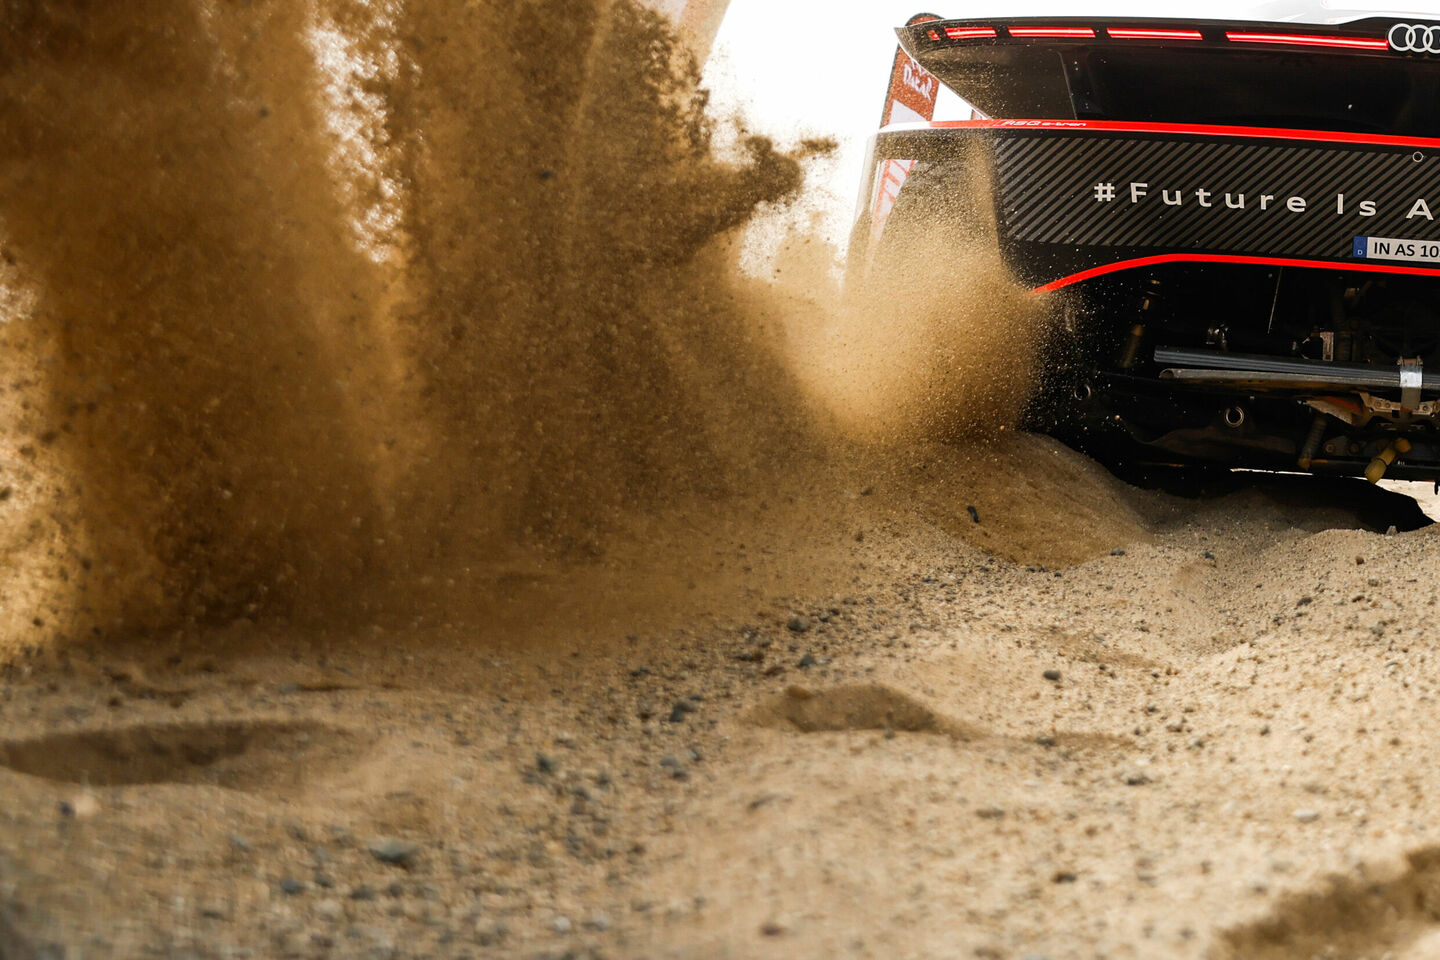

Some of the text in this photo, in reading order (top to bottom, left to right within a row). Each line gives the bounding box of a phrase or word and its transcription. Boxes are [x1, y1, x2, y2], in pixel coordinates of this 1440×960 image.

[1094, 182, 1307, 213] #Future
[1337, 193, 1377, 217] Is
[1374, 242, 1390, 255] IN
[1395, 244, 1415, 257] AS
